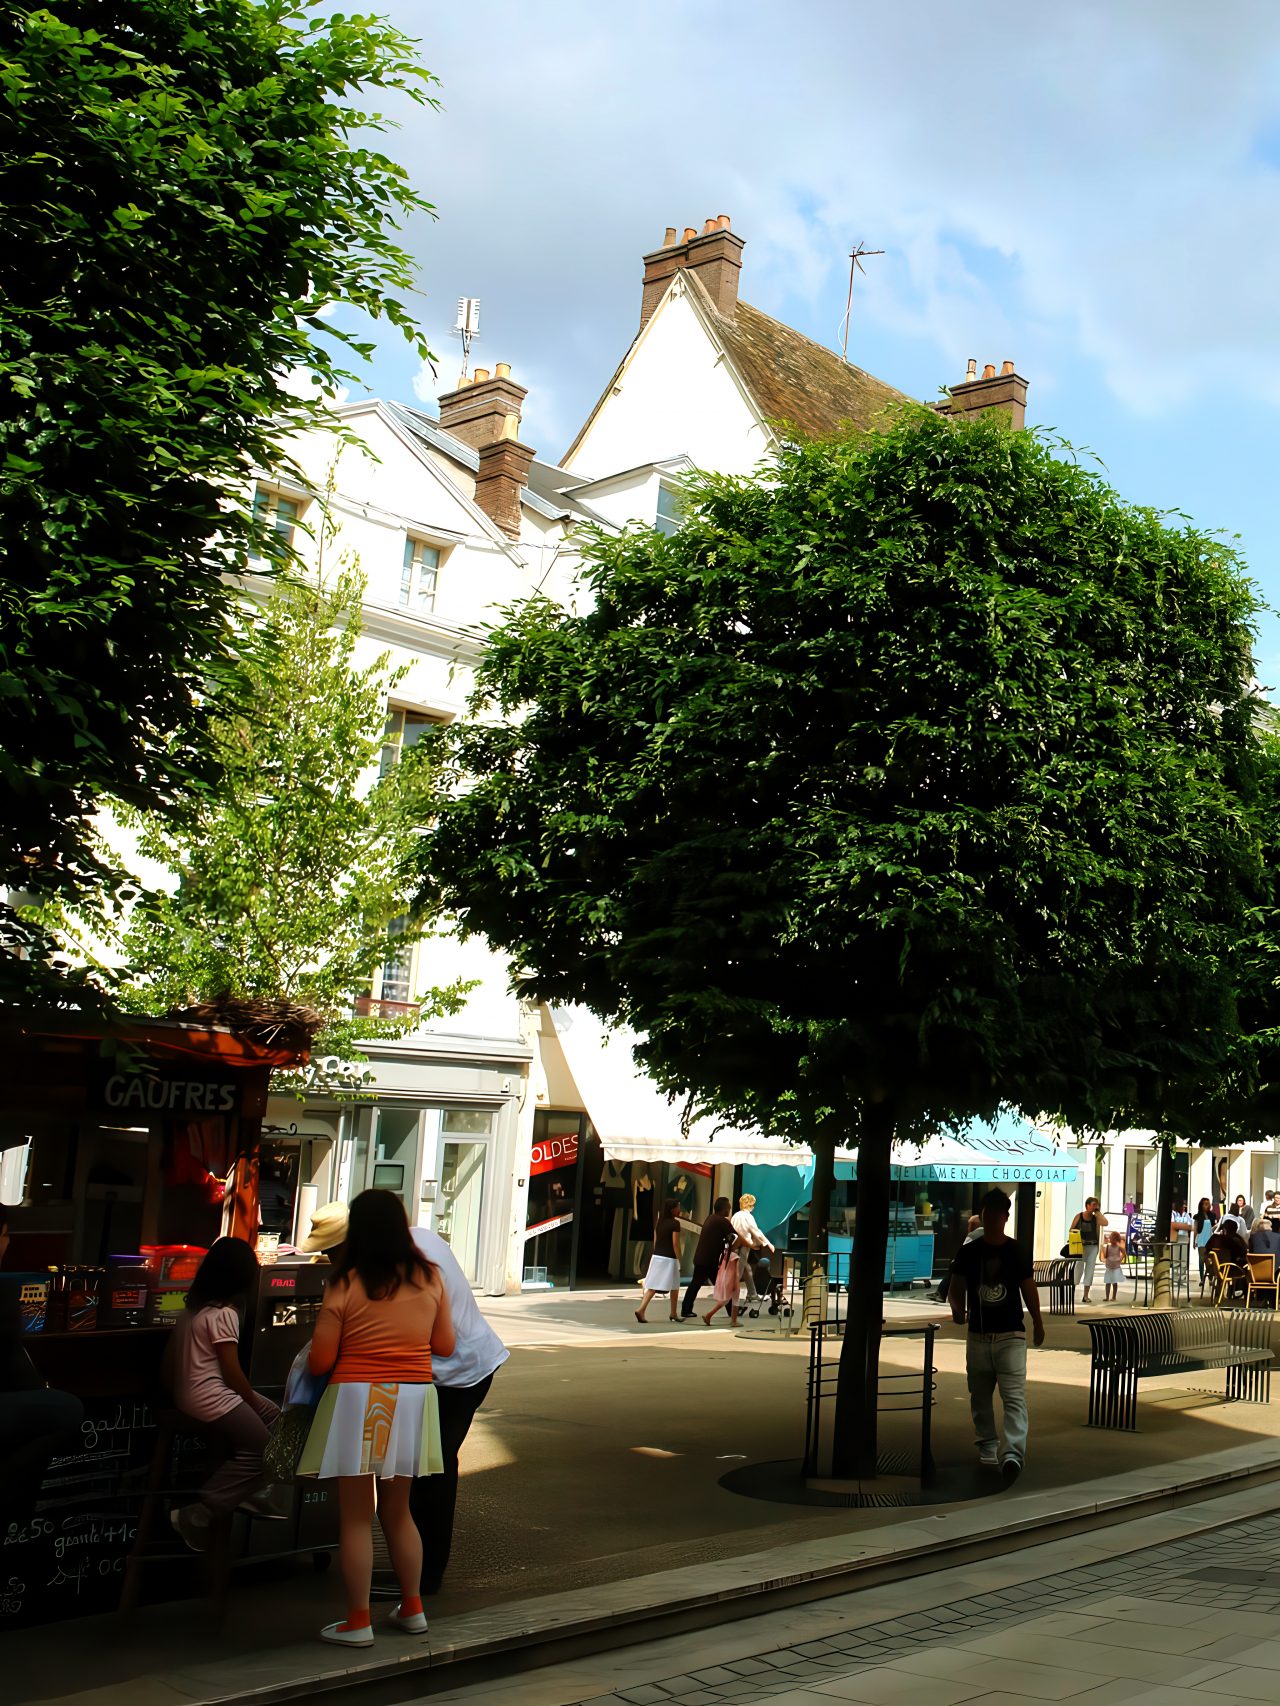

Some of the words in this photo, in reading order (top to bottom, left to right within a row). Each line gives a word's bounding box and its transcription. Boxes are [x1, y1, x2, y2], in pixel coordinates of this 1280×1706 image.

[104, 1075, 236, 1111] GAUFRES
[530, 1134, 579, 1164] OLDES
[992, 1167, 1069, 1181] CHOCOLAT
